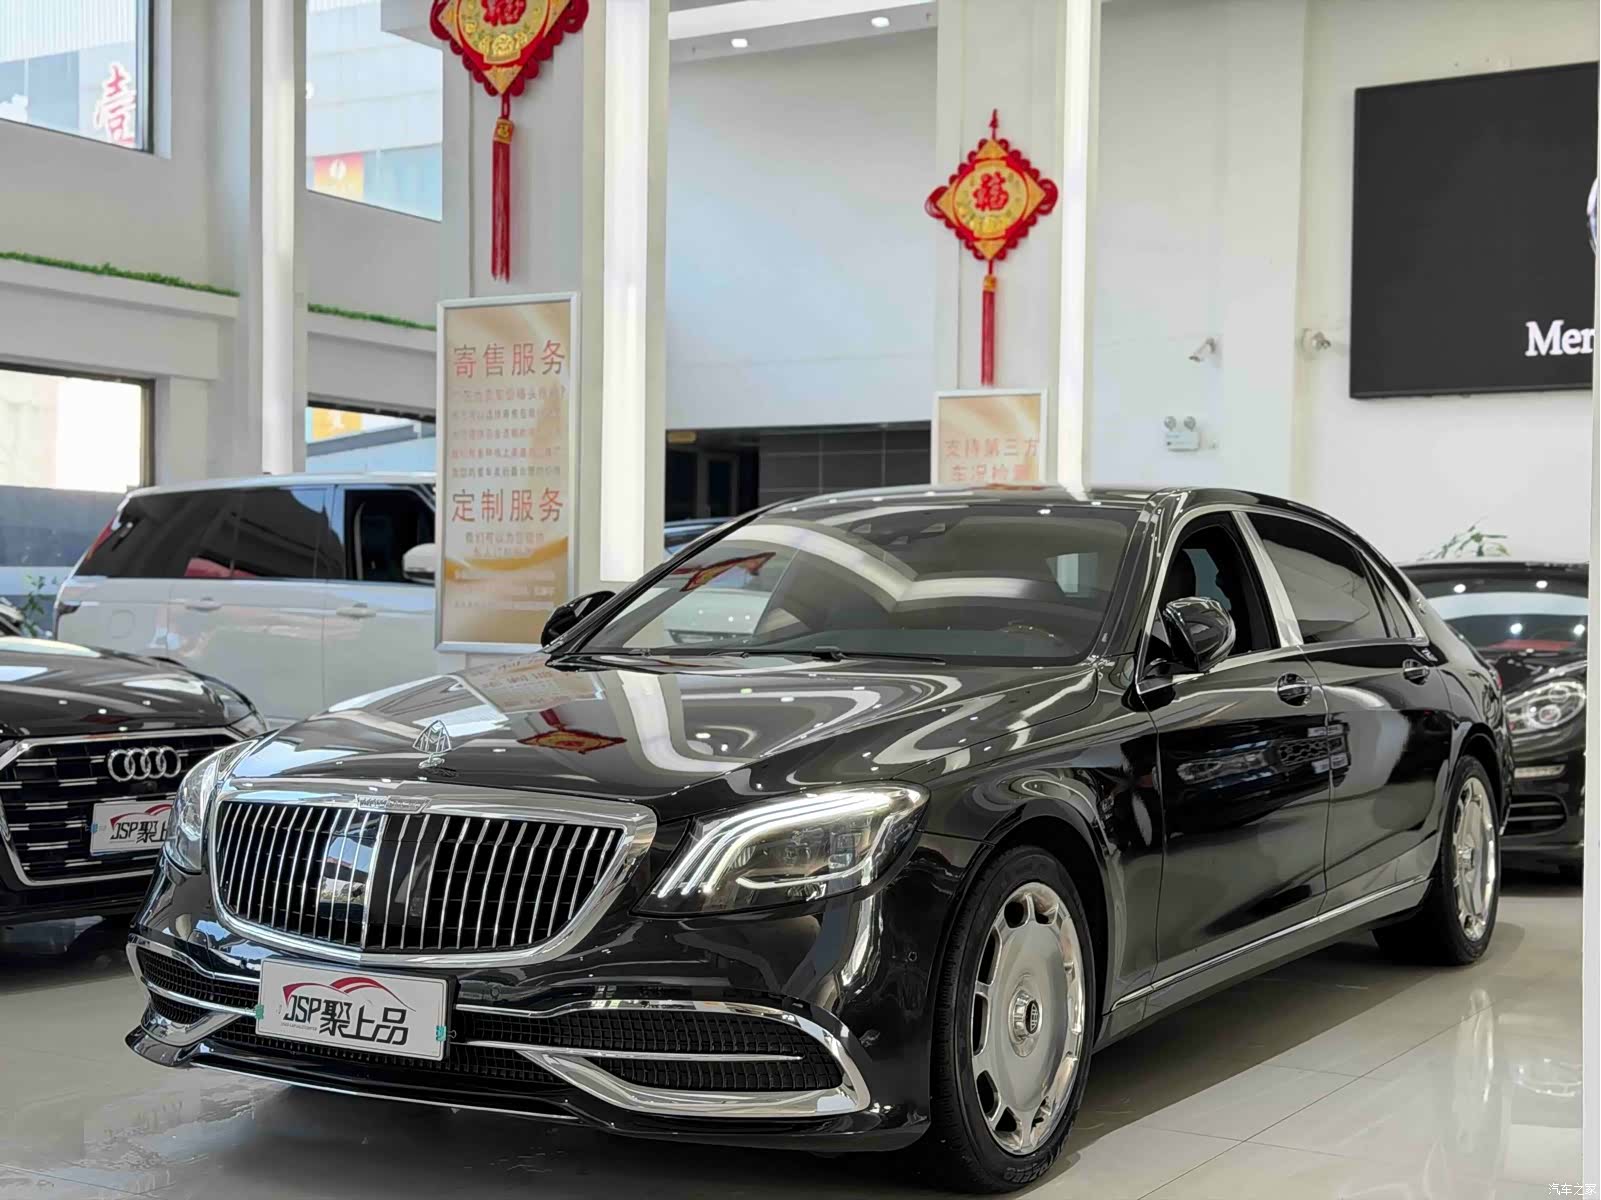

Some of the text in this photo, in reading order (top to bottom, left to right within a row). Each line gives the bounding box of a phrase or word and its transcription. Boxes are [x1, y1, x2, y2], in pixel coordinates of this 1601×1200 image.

[453, 339, 566, 379] 寄售服务
[452, 487, 564, 523] 定制服务
